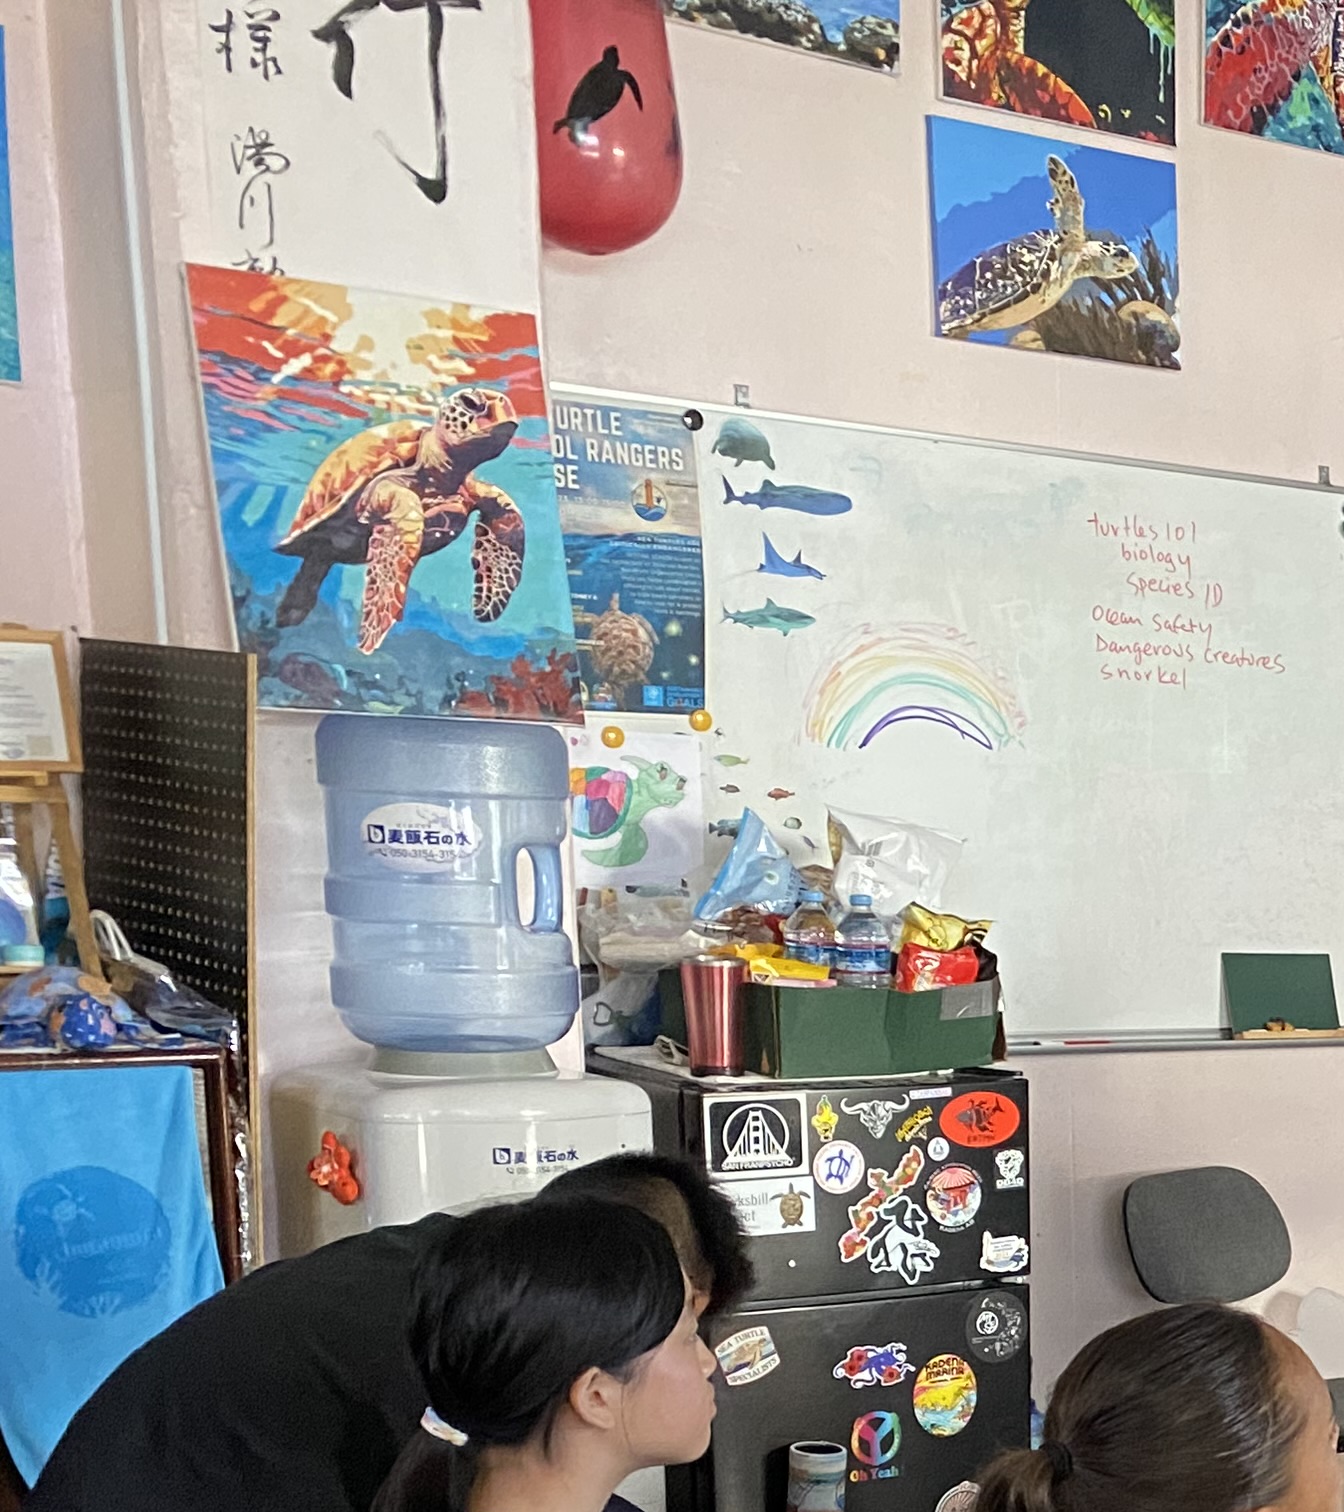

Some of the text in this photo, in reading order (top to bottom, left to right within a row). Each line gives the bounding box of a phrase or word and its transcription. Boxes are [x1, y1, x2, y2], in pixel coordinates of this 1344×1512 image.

[586, 437, 685, 472] RANGERS
[1087, 512, 1158, 540] turtles
[1122, 543, 1191, 579] biology
[1127, 572, 1223, 609] Species ID
[1096, 634, 1194, 665] Dangerous
